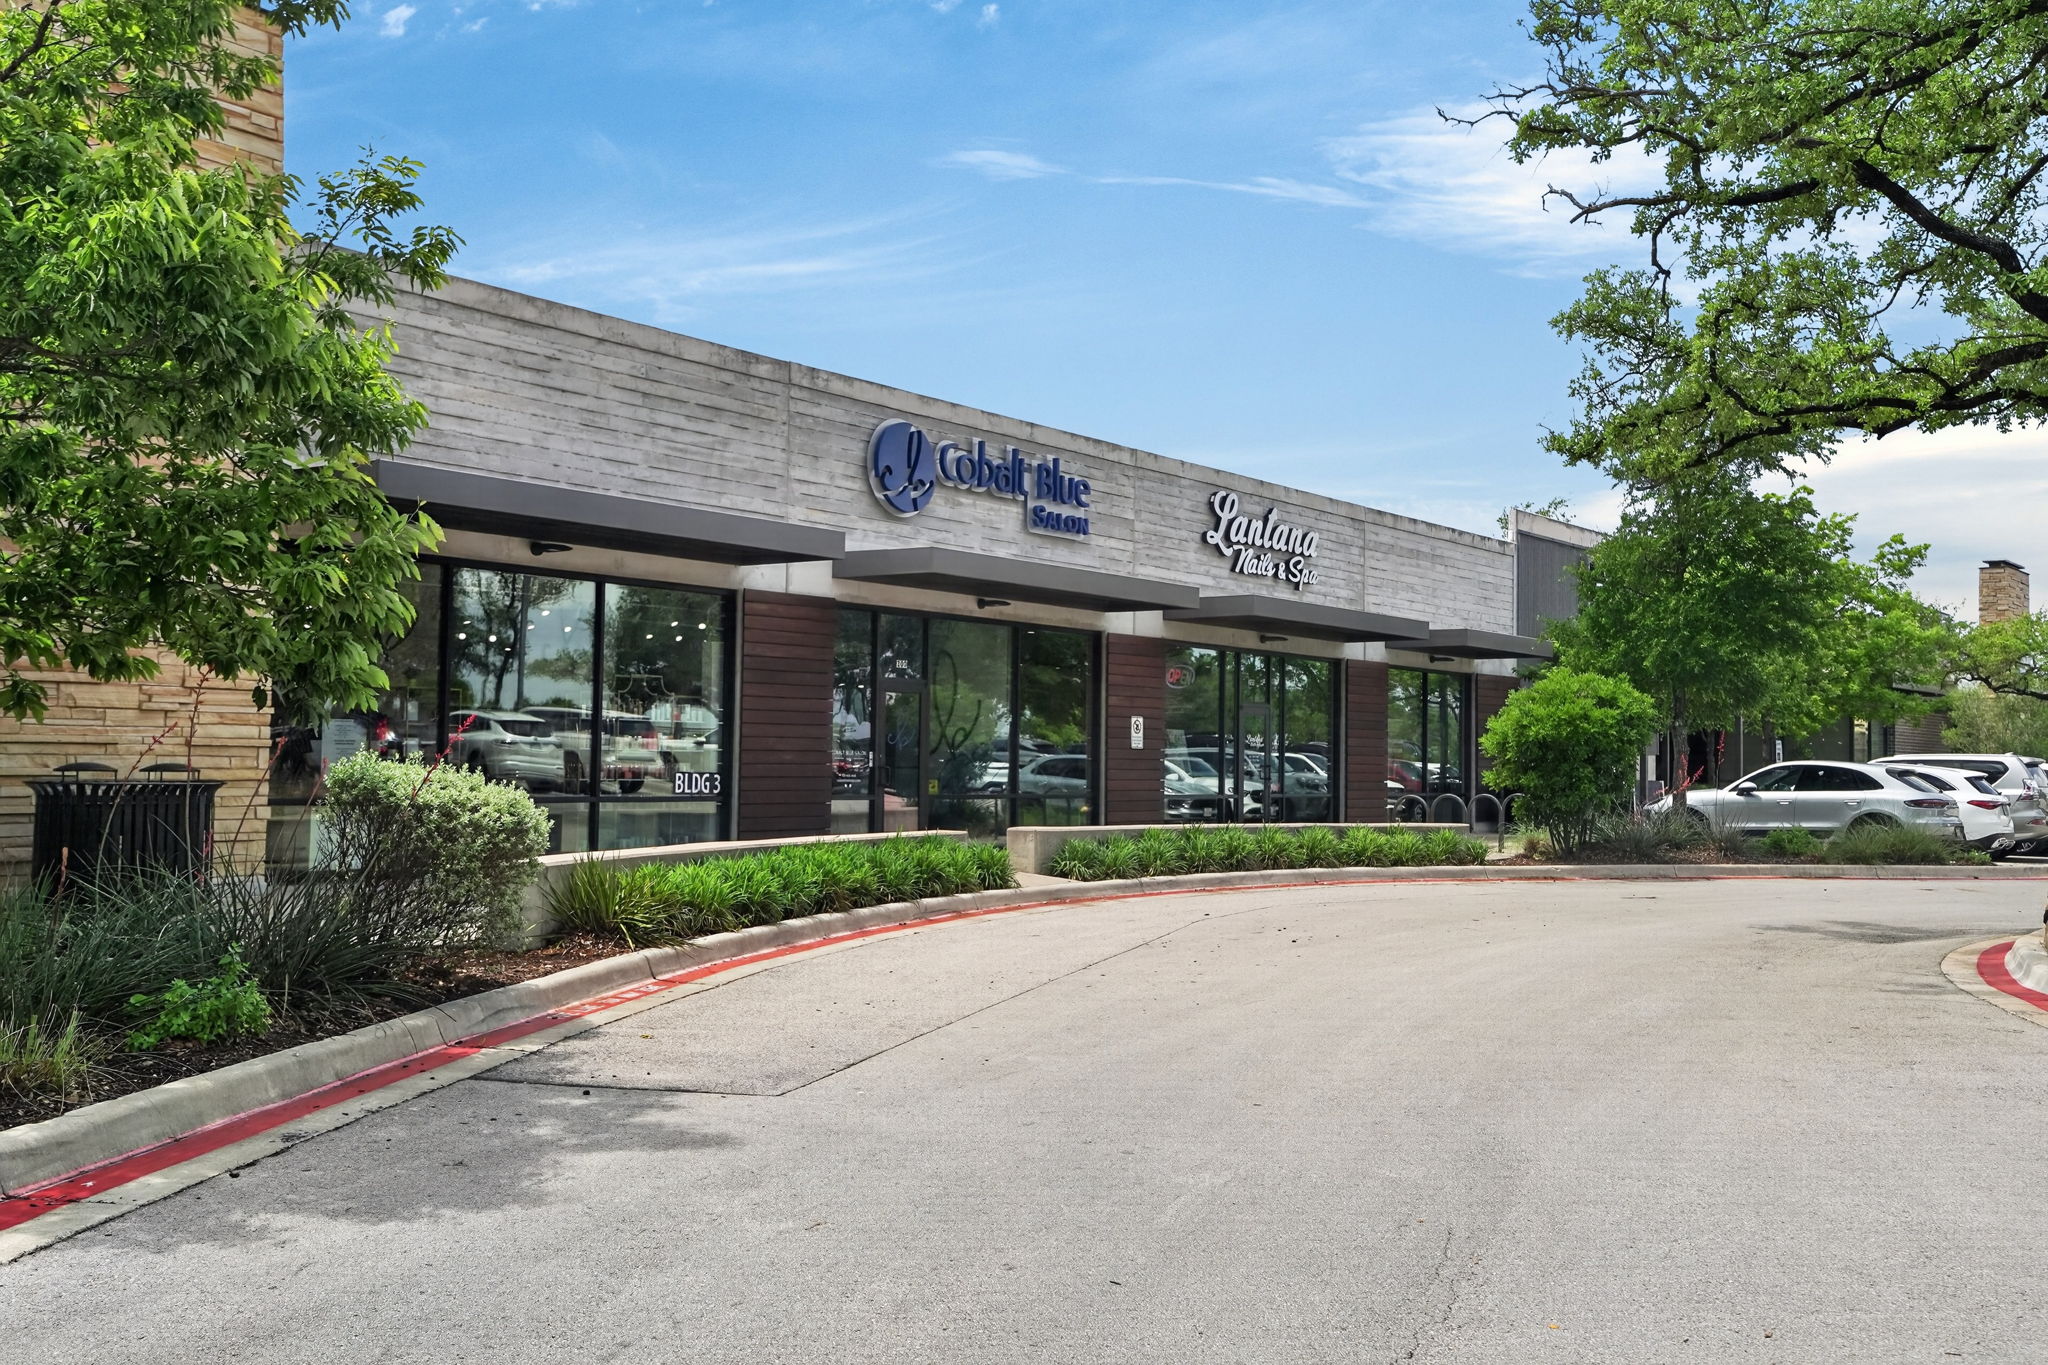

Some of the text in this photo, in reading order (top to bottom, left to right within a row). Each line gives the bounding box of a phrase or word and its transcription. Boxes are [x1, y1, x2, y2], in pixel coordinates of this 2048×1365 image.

[937, 438, 1091, 508] Cobalt Blue
[1032, 504, 1089, 535] SALON
[1206, 490, 1319, 557] Lantana
[1233, 544, 1319, 591] Nails & Spa
[1168, 668, 1191, 686] OPEN
[675, 772, 721, 794] BLDG 3
